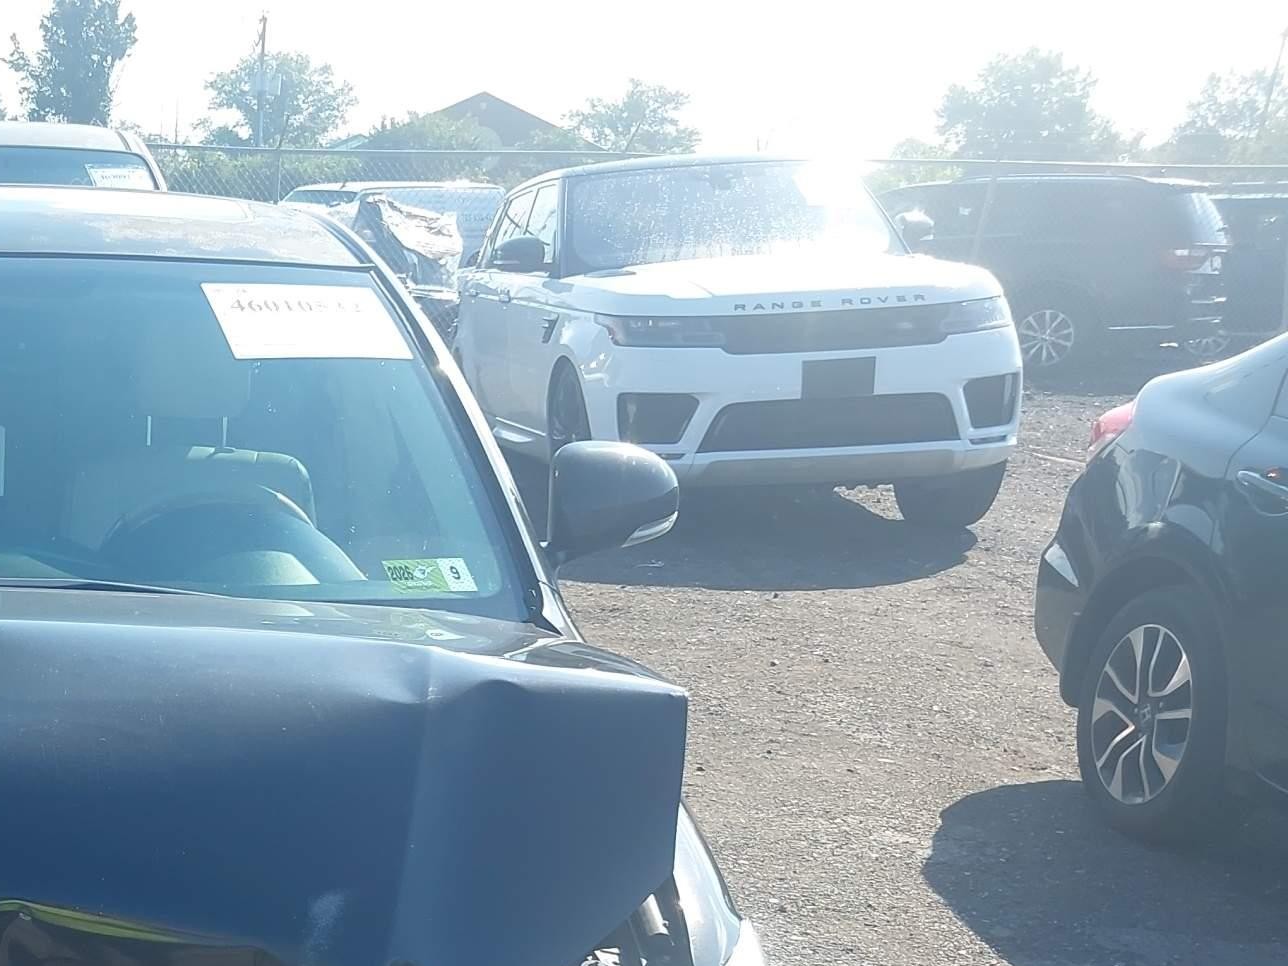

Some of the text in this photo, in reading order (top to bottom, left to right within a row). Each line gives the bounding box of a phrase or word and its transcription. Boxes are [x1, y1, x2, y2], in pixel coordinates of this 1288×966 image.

[230, 298, 362, 313] 460102
[733, 294, 926, 312] RANGE ROVER
[449, 565, 461, 580] 9
